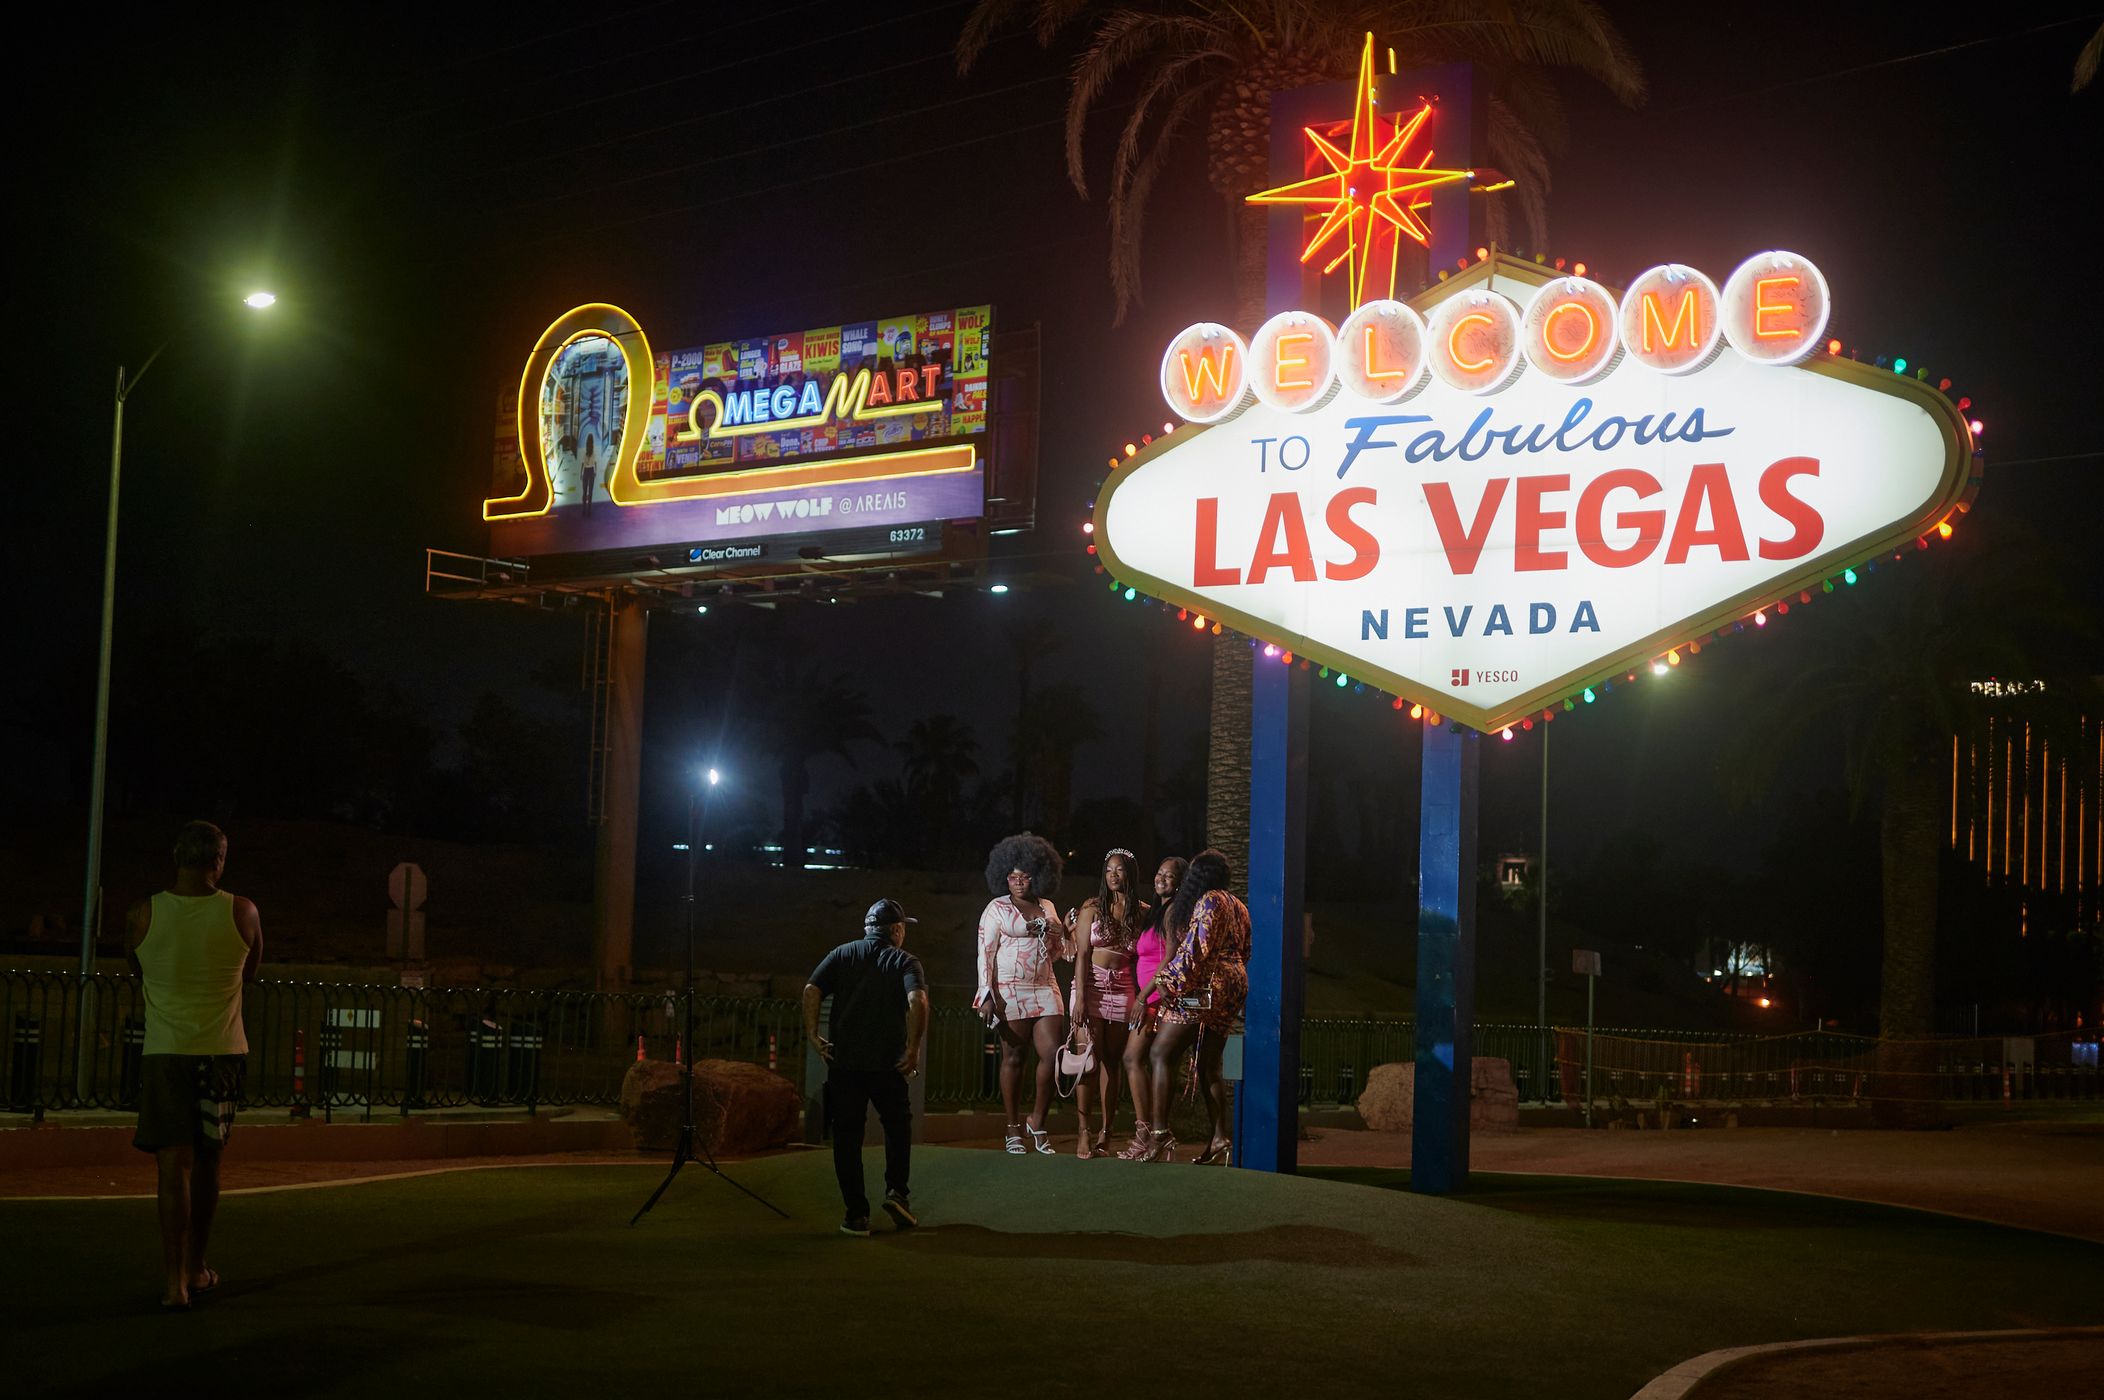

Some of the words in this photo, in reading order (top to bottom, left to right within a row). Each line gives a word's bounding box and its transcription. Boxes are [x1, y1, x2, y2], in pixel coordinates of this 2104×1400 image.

[959, 315, 984, 330] WOLF
[843, 328, 868, 341] WHALE
[1168, 270, 1810, 404] WELCOME
[805, 341, 839, 360] KIWIS
[842, 341, 863, 354] SONG
[671, 351, 703, 368] P-2000
[820, 363, 943, 421] MART
[1251, 434, 1311, 473] TO
[1336, 397, 1736, 479] Fabulous
[716, 502, 775, 526] MEOW
[776, 497, 833, 520] WOLF
[839, 498, 852, 514] @
[1193, 486, 1381, 588] LAS
[1422, 456, 1826, 576] VEGAS
[889, 528, 924, 542] 63372
[702, 549, 725, 561] Clear
[725, 545, 761, 558] Channel
[1361, 601, 1602, 641] NEVADA
[1476, 670, 1519, 683] YESCO
